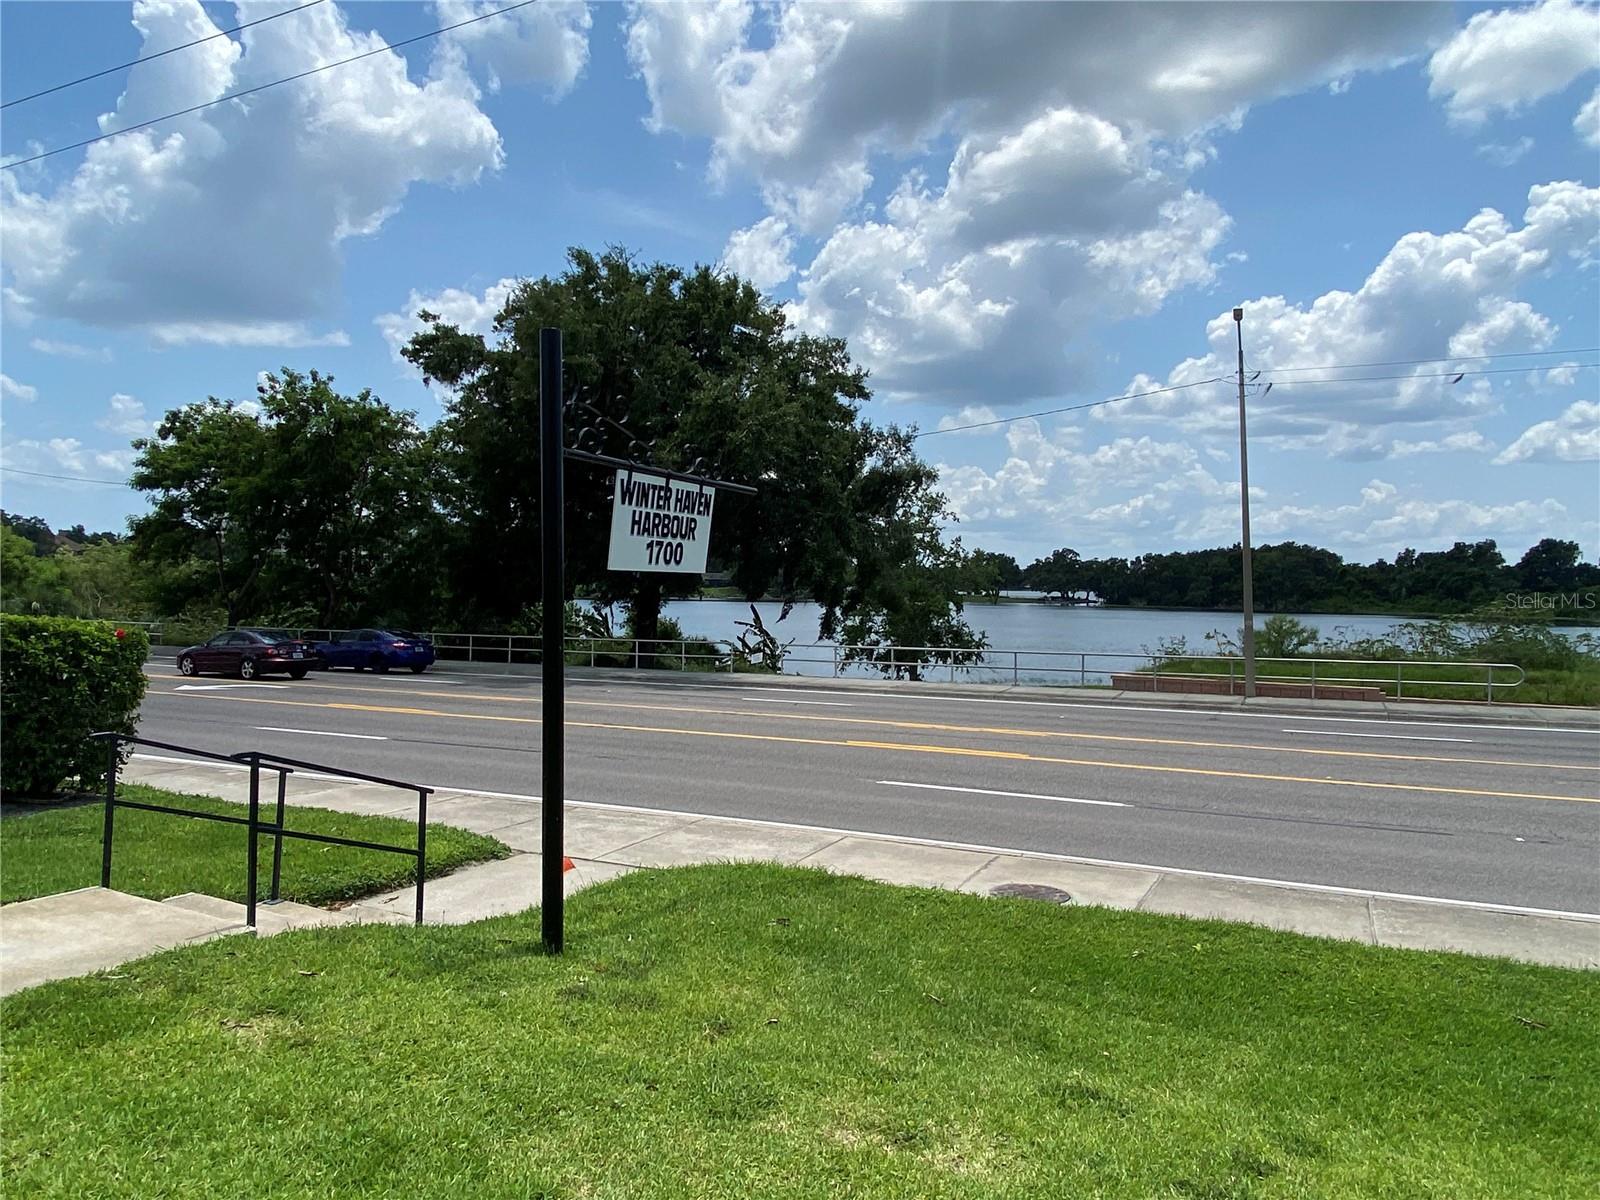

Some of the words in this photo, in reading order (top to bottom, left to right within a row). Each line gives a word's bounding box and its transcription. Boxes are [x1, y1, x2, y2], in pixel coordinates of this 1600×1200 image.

[620, 478, 673, 512] WINTER
[674, 488, 713, 517] HAVEN
[630, 509, 698, 541] HARBOUR
[646, 540, 684, 566] 1700
